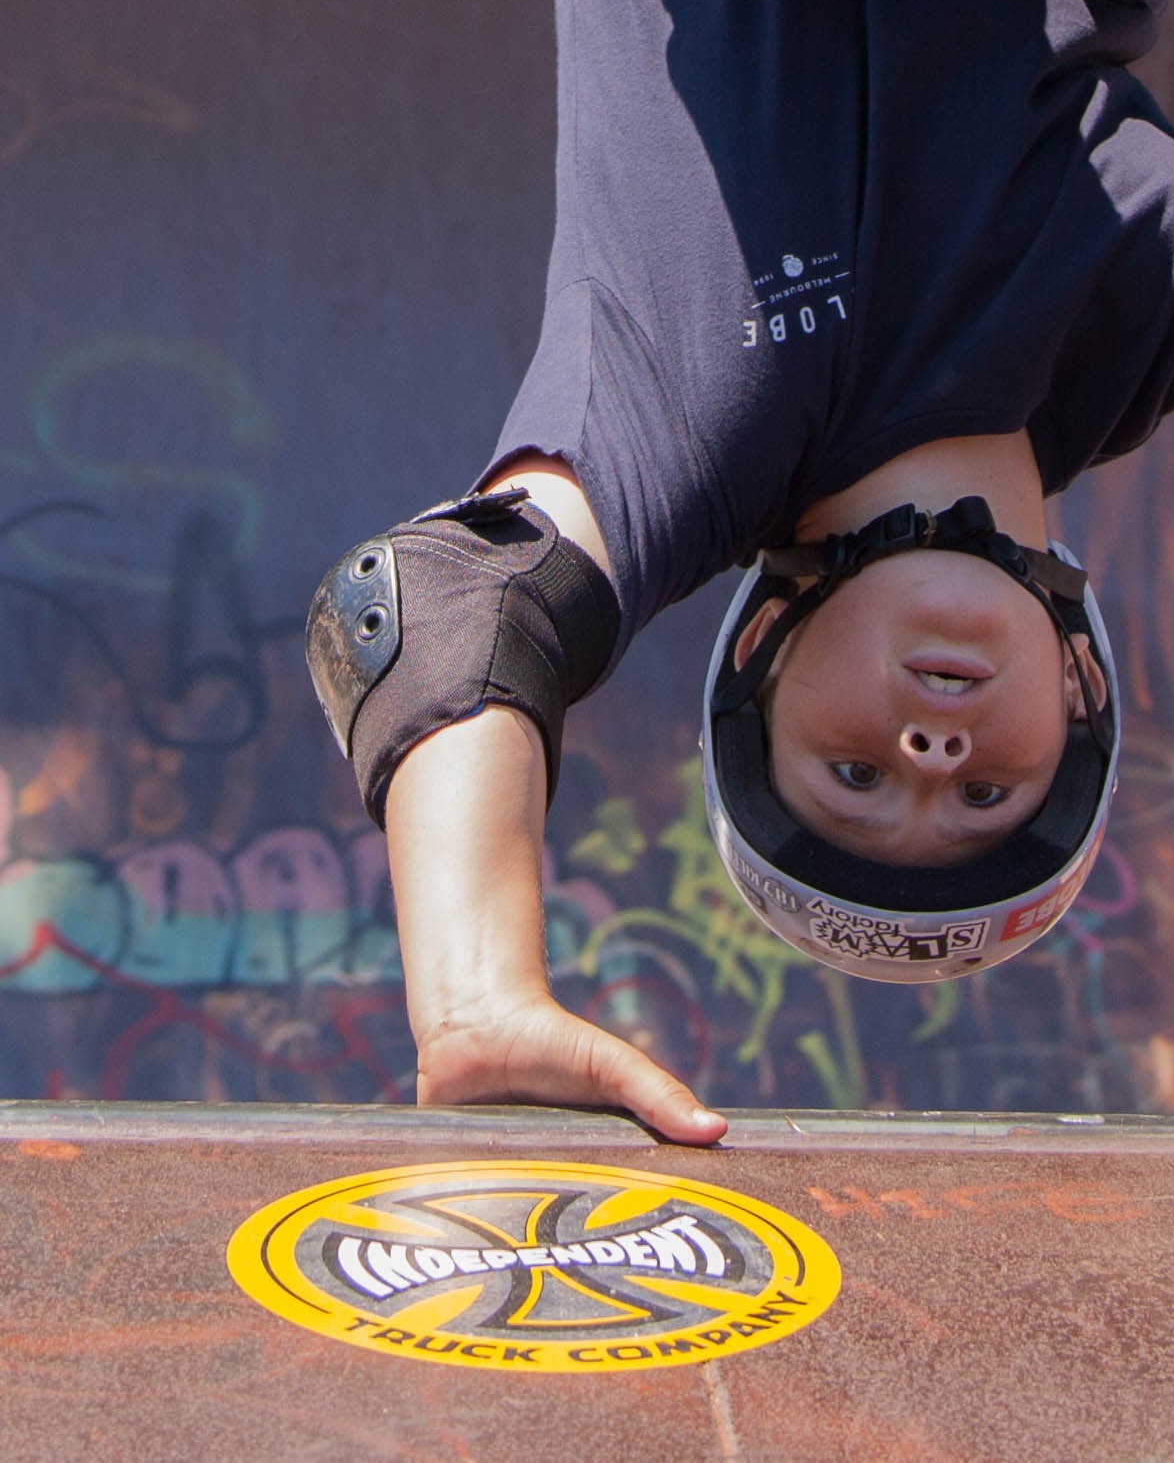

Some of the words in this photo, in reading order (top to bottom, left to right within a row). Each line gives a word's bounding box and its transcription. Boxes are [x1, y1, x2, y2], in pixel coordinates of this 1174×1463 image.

[769, 276, 832, 304] MELBOURNE
[743, 294, 848, 347] LOBE
[811, 899, 900, 935] factory
[818, 921, 985, 960] SLAM
[337, 1214, 727, 1299] INDEPENDENT
[344, 1316, 538, 1364] TRUCK
[568, 1289, 811, 1363] COMPANY
